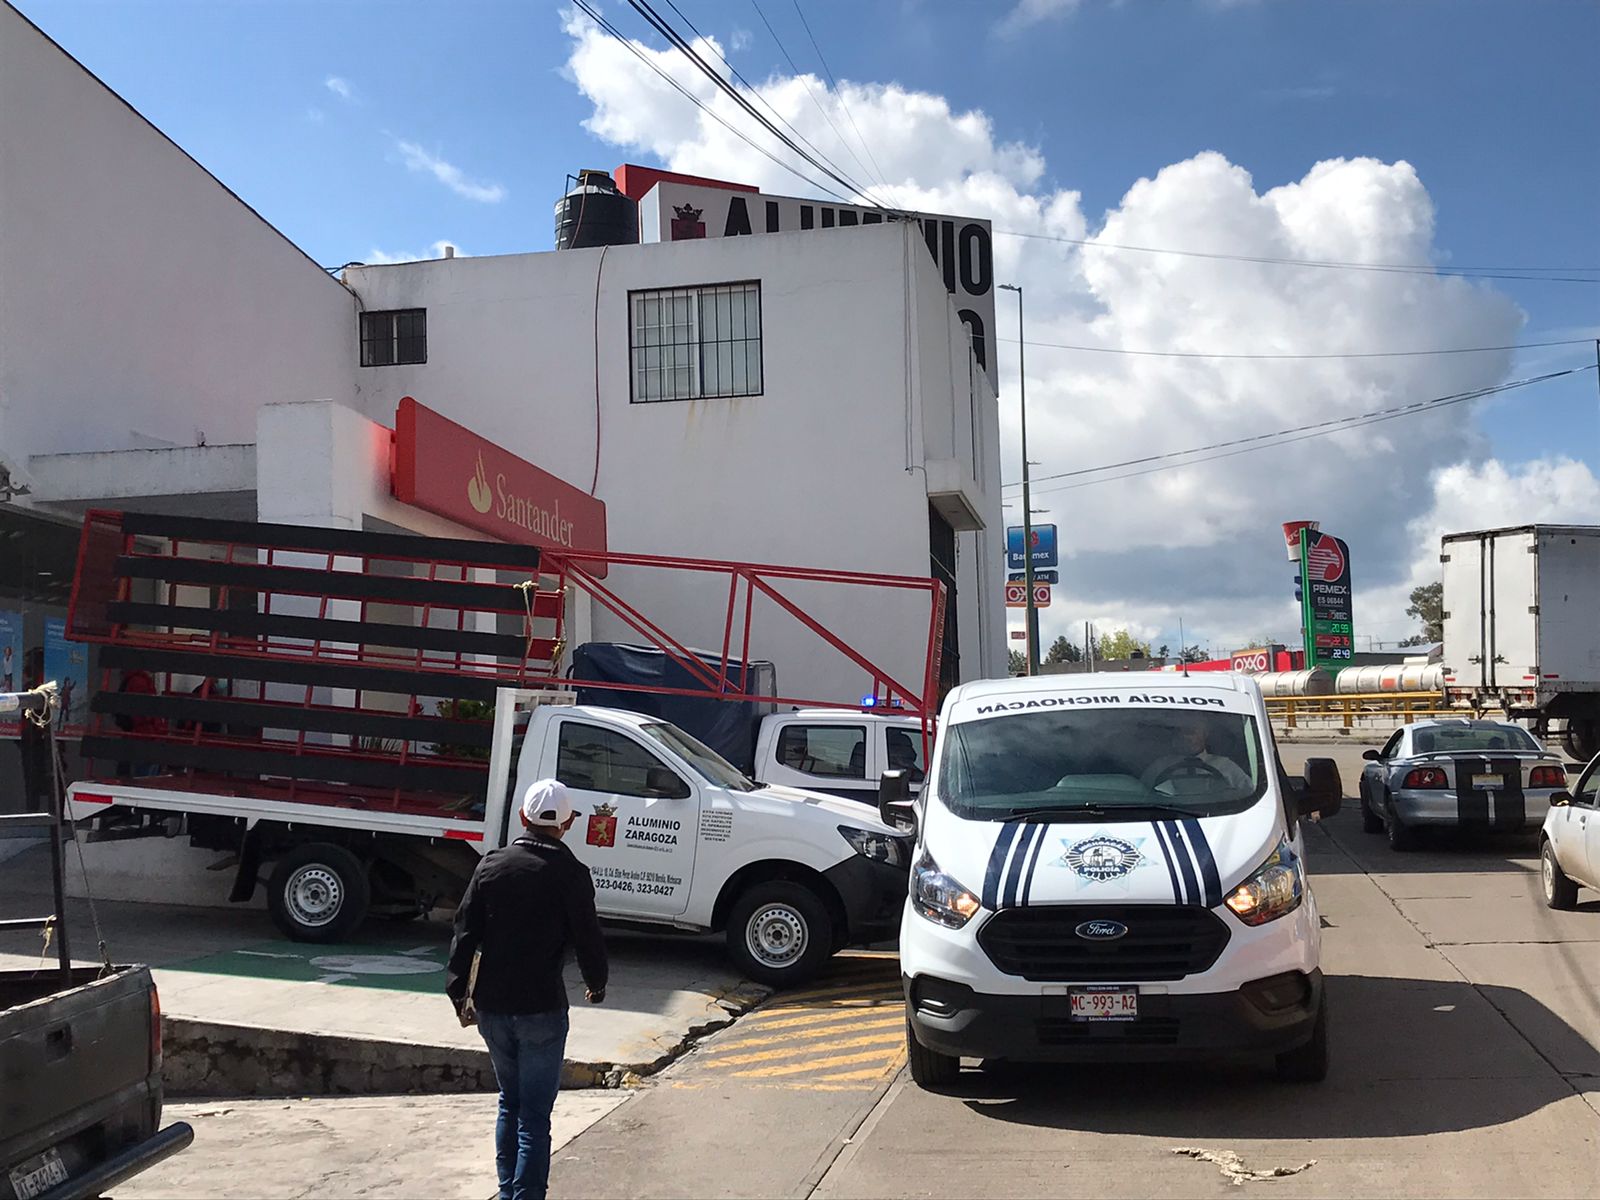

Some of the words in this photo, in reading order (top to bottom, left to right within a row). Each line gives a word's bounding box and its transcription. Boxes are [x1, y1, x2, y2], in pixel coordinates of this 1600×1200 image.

[496, 473, 574, 548] Santander
[1012, 552, 1049, 561] Bamex
[1312, 584, 1347, 594] PEMEX
[1233, 653, 1267, 672] OXXO
[627, 816, 681, 831] ALUMINIO
[624, 829, 678, 845] ZARAGOZA
[595, 878, 635, 893] 323-0426,
[637, 883, 674, 896] 323-0427
[1086, 923, 1116, 936] Ford
[1071, 995, 1136, 1011] MC-993-A2
